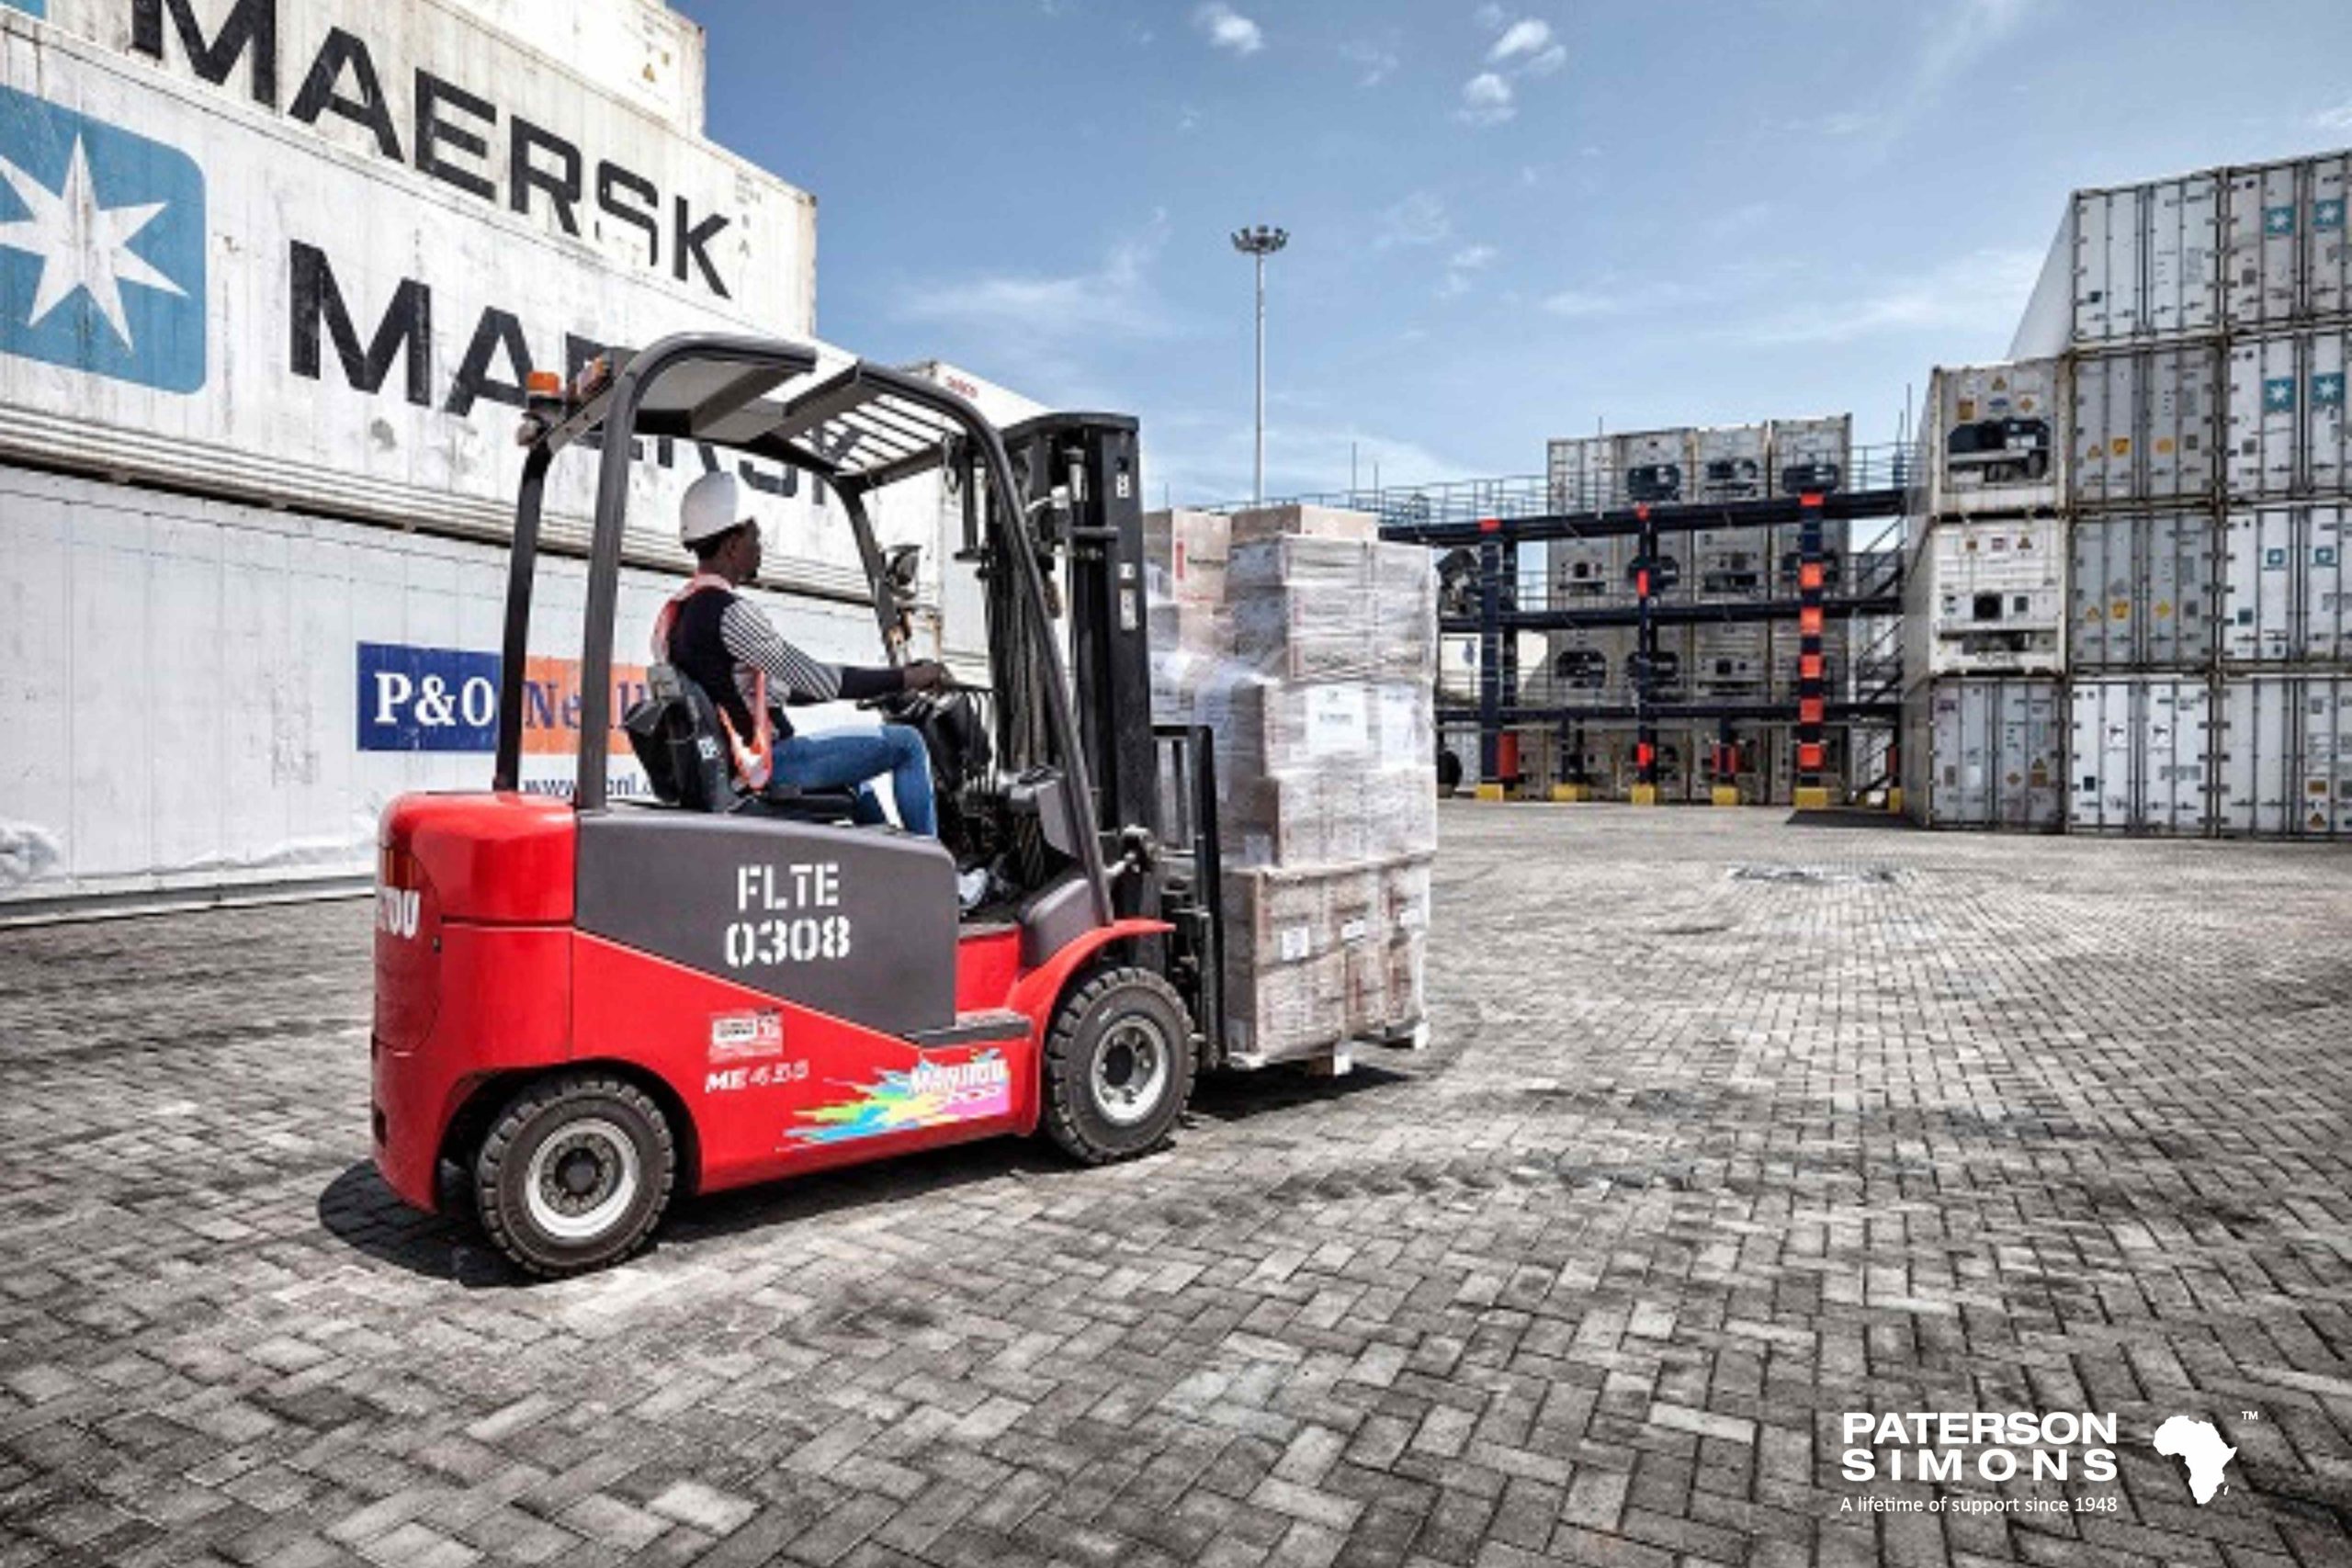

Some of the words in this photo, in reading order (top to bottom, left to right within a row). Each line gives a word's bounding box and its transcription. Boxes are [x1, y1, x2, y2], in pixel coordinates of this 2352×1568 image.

[131, 0, 732, 300] MAERSK
[374, 671, 495, 727] P&O
[737, 863, 840, 911] FLTE
[726, 915, 851, 967] 0308
[704, 1066, 751, 1094] ME
